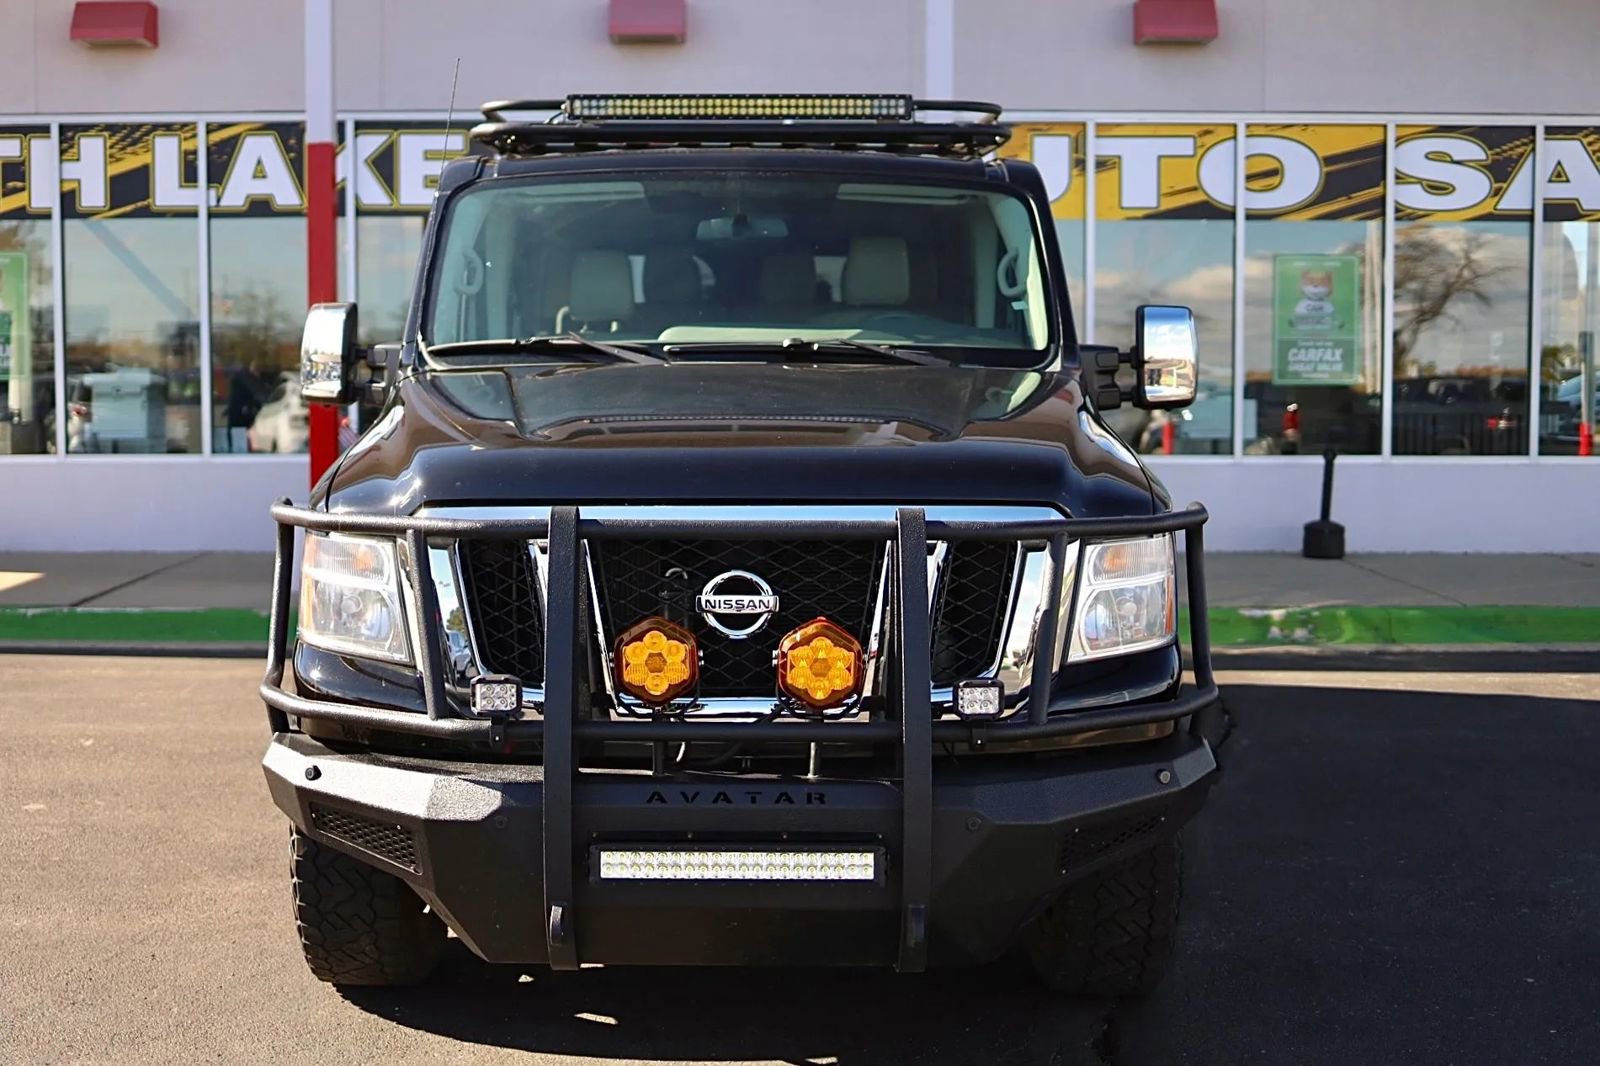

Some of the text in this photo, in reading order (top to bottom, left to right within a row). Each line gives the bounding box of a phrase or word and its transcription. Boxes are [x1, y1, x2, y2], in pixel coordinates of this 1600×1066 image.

[151, 129, 470, 212] LAKE
[1390, 133, 1600, 213] SA
[704, 599, 770, 609] NISSAN
[646, 791, 826, 804] AVATAR
